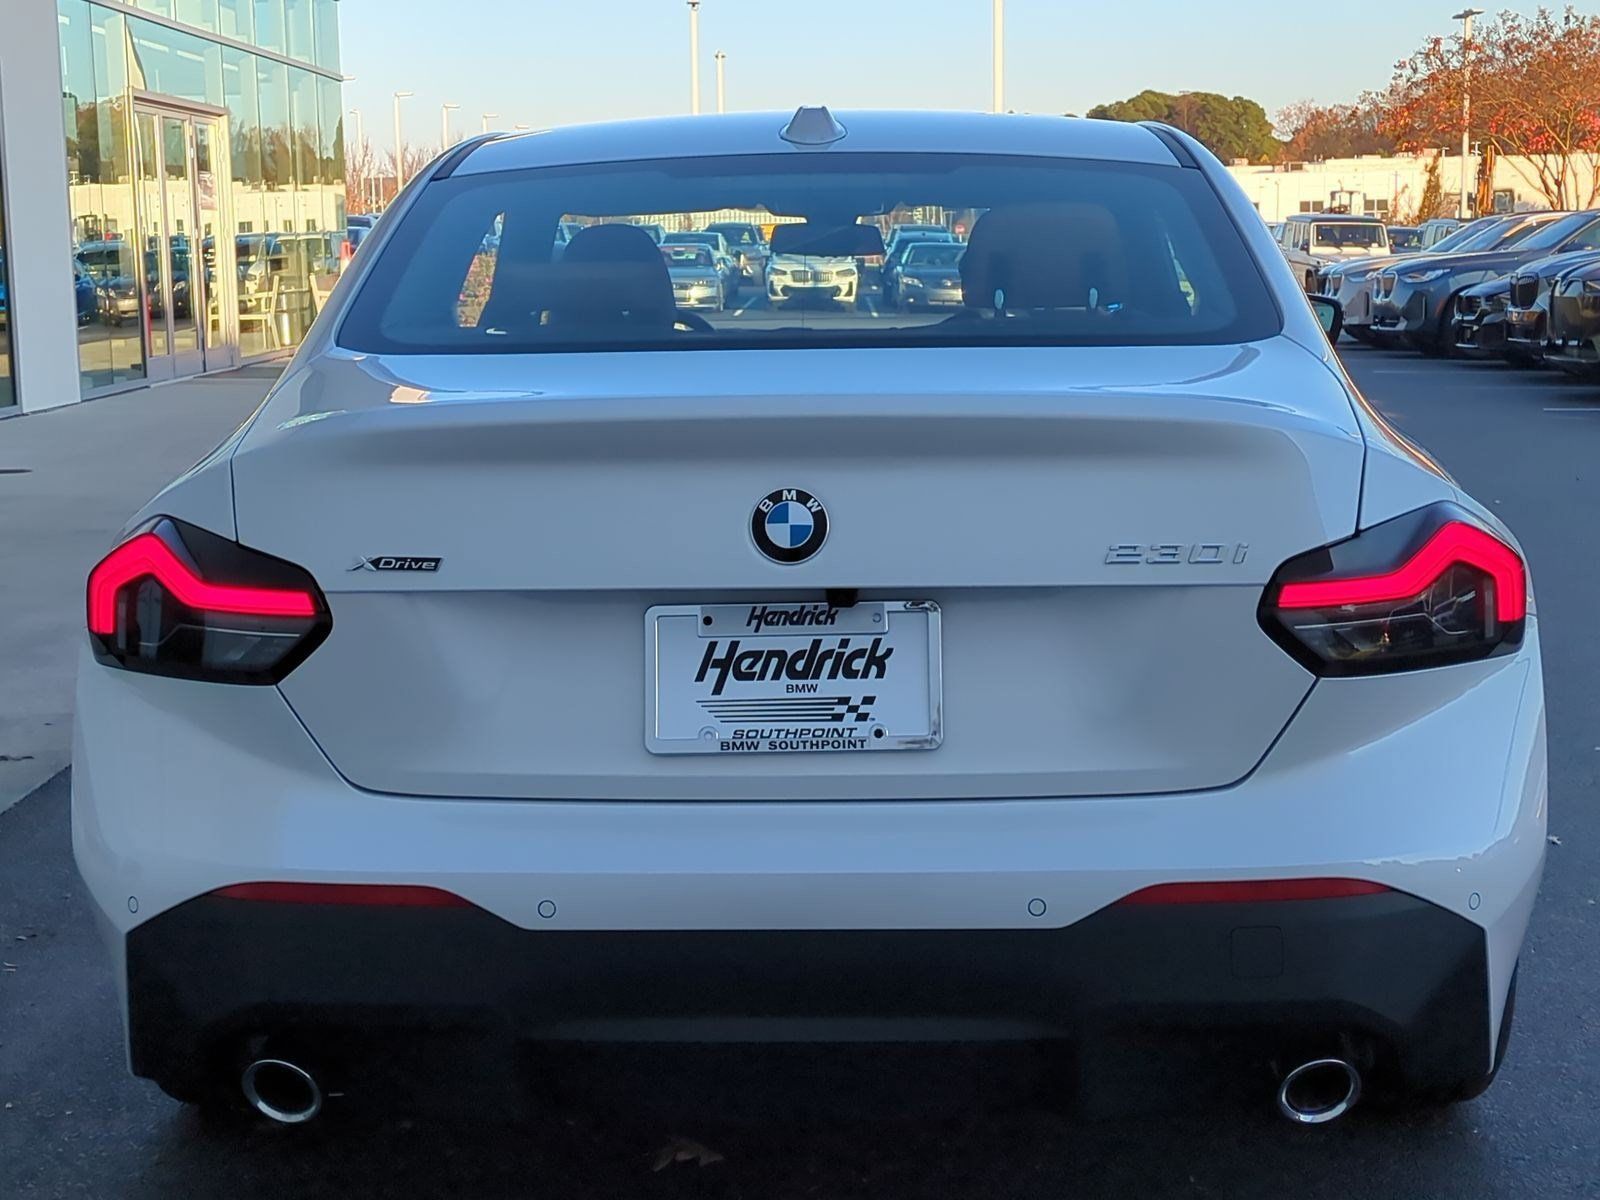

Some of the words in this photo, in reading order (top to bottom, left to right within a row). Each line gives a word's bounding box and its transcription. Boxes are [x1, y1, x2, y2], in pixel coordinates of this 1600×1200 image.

[759, 489, 822, 513] BMW
[1104, 543, 1249, 565] 230i
[746, 605, 839, 633] Hendrick
[694, 637, 894, 696] Hendrick
[785, 683, 819, 694] BMW
[731, 727, 858, 739] SOUTHPOINT
[720, 741, 760, 751] BMW
[768, 739, 867, 751] SOUTHPOINT
